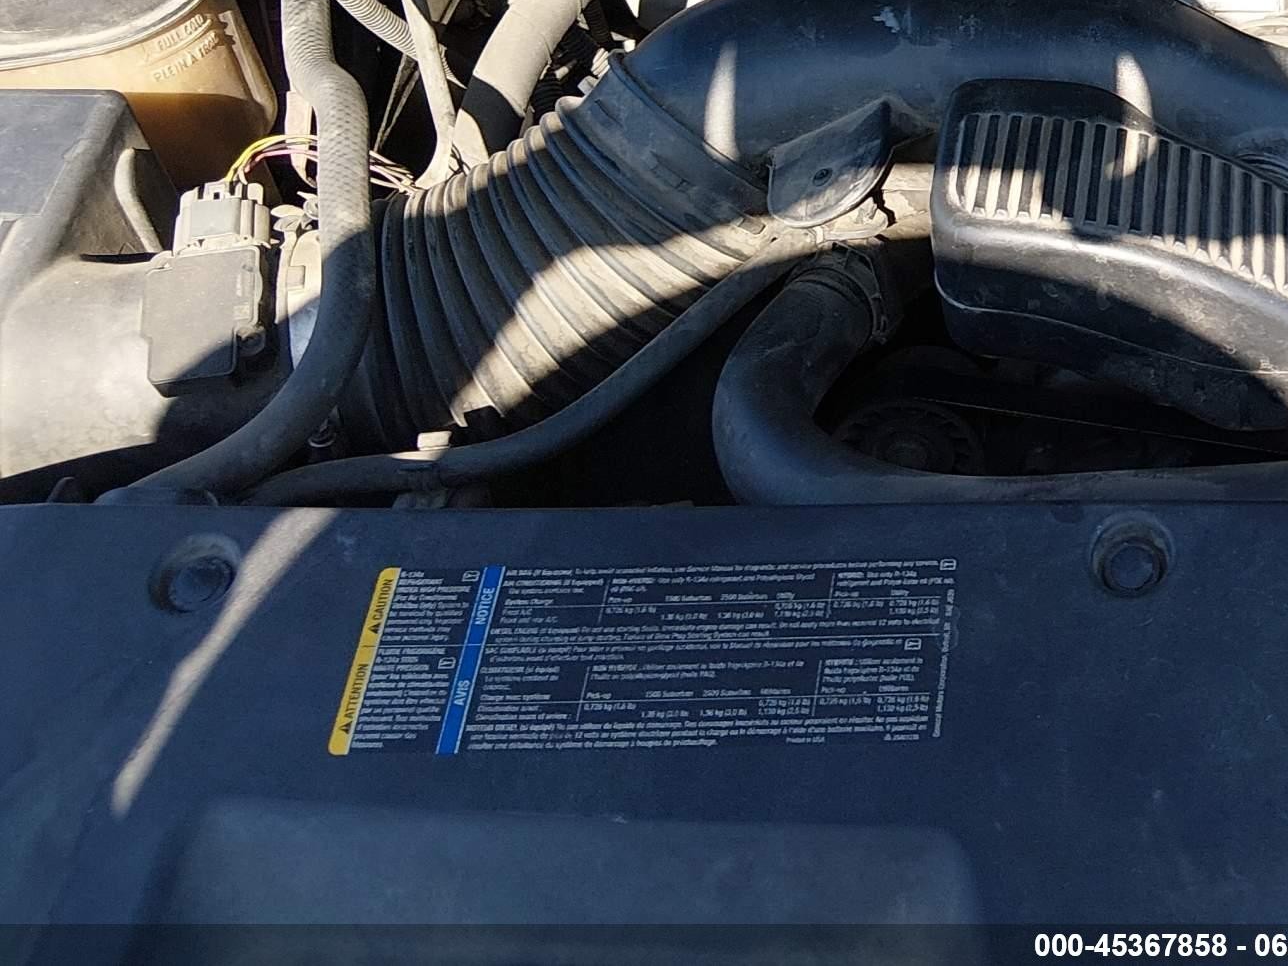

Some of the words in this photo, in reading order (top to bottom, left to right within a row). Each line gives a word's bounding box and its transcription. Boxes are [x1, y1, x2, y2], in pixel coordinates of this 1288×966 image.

[157, 31, 184, 51] FULL
[373, 578, 394, 621] CAUTION
[475, 587, 496, 626] NOTICE
[345, 662, 370, 720] ATTENTION
[453, 679, 471, 707] AVIS
